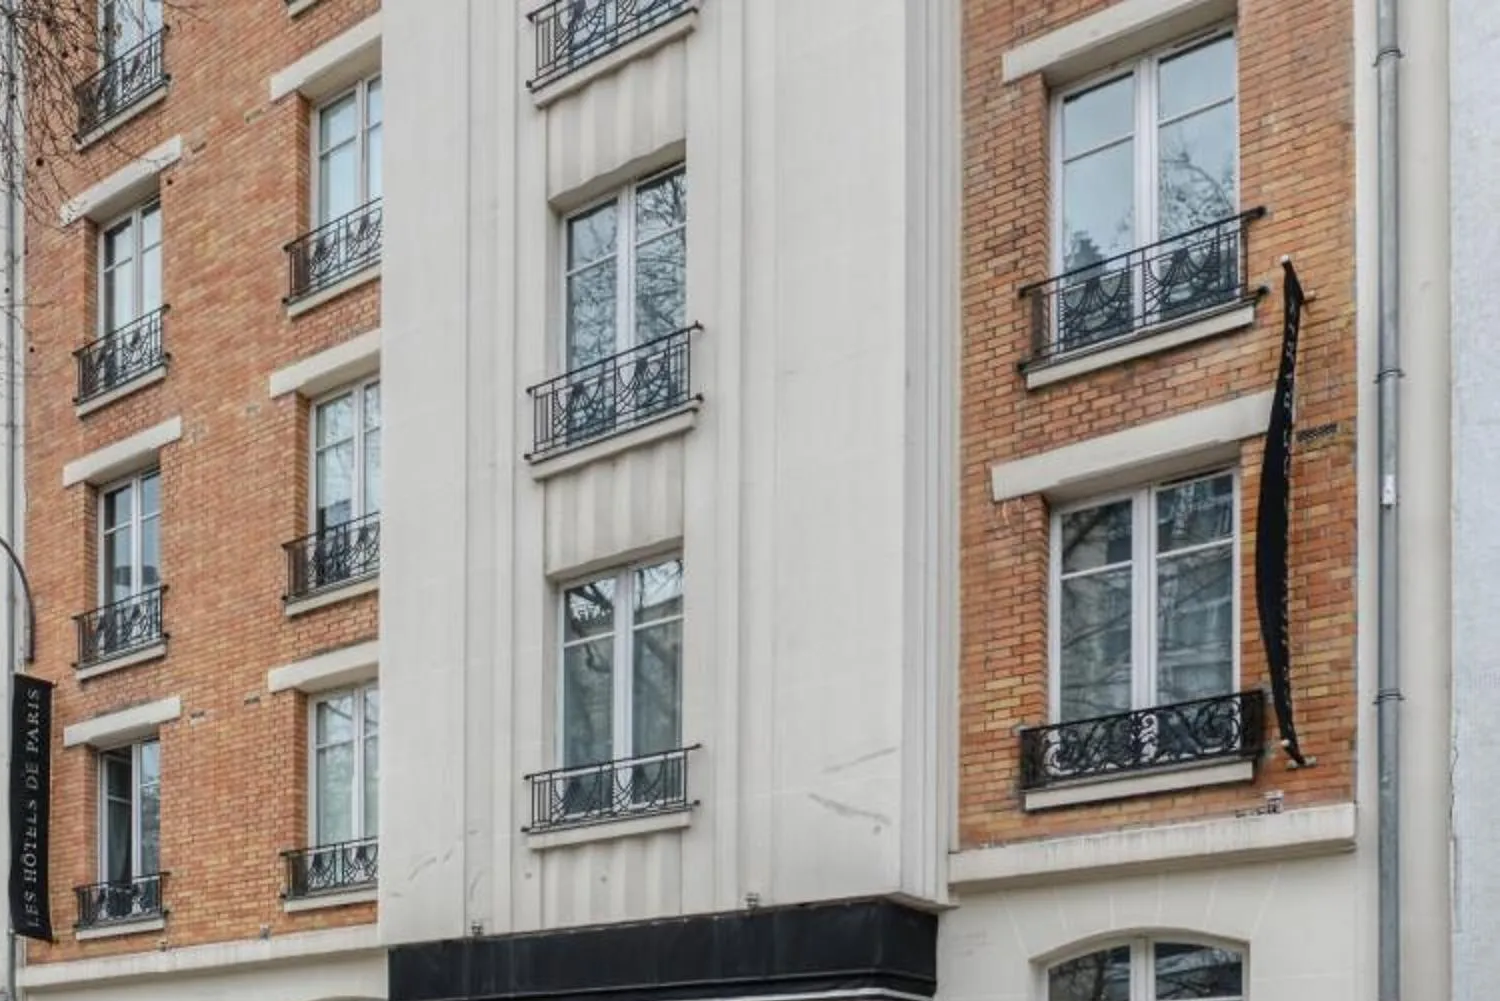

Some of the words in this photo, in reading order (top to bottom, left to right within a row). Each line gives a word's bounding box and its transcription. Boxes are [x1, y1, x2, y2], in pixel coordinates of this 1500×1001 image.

[25, 687, 41, 753] PARIS
[25, 760, 40, 790] DE
[24, 889, 40, 928] LES
